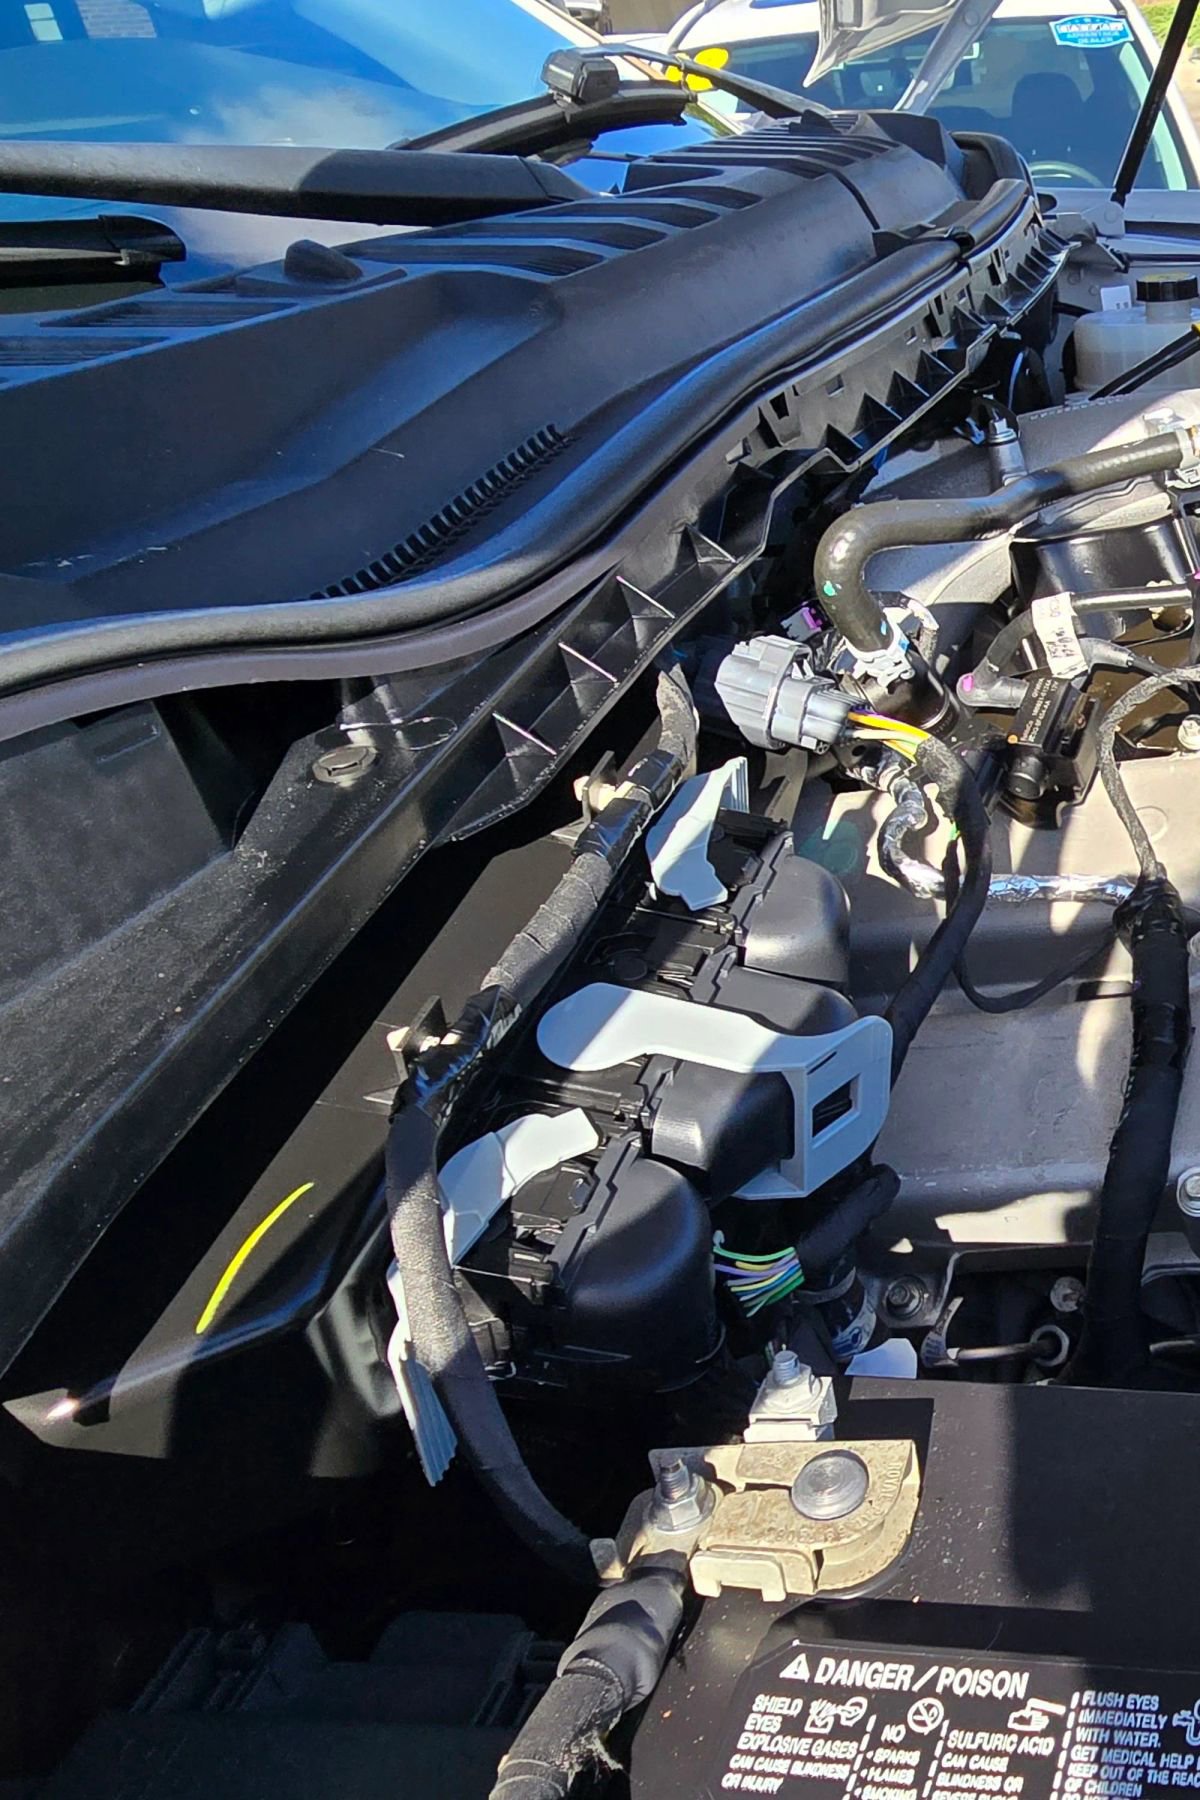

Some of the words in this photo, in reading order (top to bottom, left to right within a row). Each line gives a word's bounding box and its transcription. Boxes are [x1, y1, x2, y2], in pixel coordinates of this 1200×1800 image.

[814, 1657, 915, 1691] DANGER
[935, 1666, 1030, 1699] POISON
[752, 1694, 803, 1716] SHIELD
[1082, 1690, 1125, 1708] FLUSH
[1126, 1693, 1160, 1711] EYES
[744, 1713, 782, 1733] EYES
[1078, 1708, 1169, 1729] IMMEDIATELY
[881, 1724, 906, 1743] NO
[947, 1729, 1018, 1753] SULFURIC
[1017, 1735, 1055, 1756] ACID
[1076, 1726, 1110, 1744] WITH
[1113, 1729, 1162, 1748] WATER.
[737, 1731, 813, 1755] EXPLOSIVE
[811, 1738, 859, 1760] GASES
[729, 1754, 755, 1770] CAN
[753, 1757, 791, 1775] CAUSE
[790, 1761, 851, 1780] BLINDNESS
[873, 1747, 921, 1766] SPARKS
[941, 1752, 967, 1769] CAN
[969, 1754, 1010, 1773] CAUSE
[1070, 1744, 1099, 1762] GET
[1100, 1748, 1156, 1768] MEDICAL
[1159, 1752, 1195, 1769] HELP
[721, 1773, 743, 1789] OR
[740, 1775, 784, 1794] INJURY
[866, 1766, 915, 1785] FLAMES
[935, 1772, 1001, 1791] BLINDNESS
[1003, 1776, 1024, 1793] OR
[1068, 1762, 1099, 1778] KEEP
[1100, 1765, 1124, 1780] OUT
[1127, 1767, 1144, 1781] OF
[1147, 1769, 1170, 1785] THE
[1064, 1777, 1083, 1792] OF
[1084, 1780, 1142, 1798] CHILDREN
